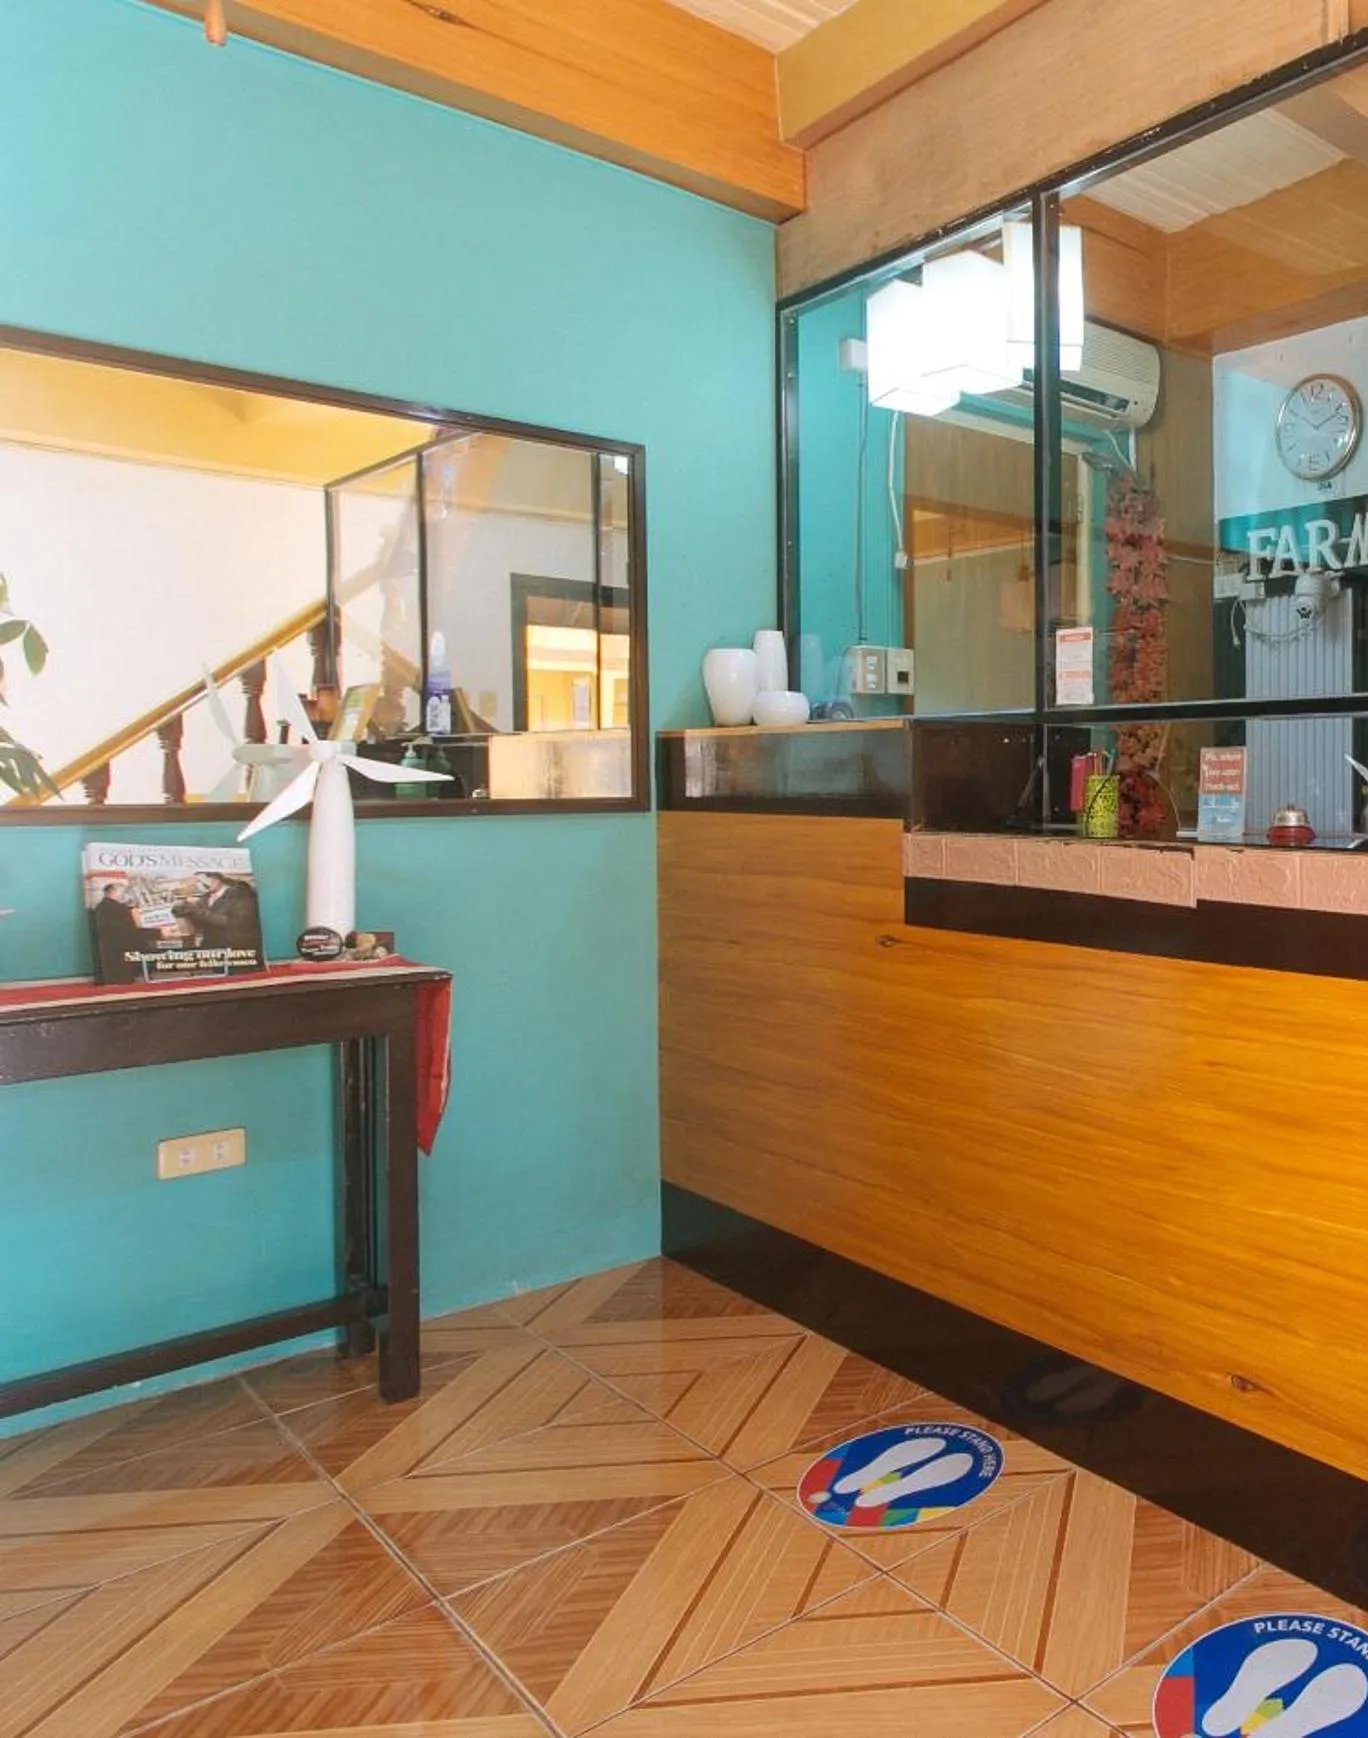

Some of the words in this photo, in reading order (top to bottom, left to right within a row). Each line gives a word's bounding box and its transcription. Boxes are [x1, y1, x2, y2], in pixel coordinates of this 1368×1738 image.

[904, 1426, 961, 1437] PLEASE
[958, 1431, 993, 1453] STAND
[979, 1452, 996, 1478] HERE
[1253, 1619, 1326, 1635] PLEASE
